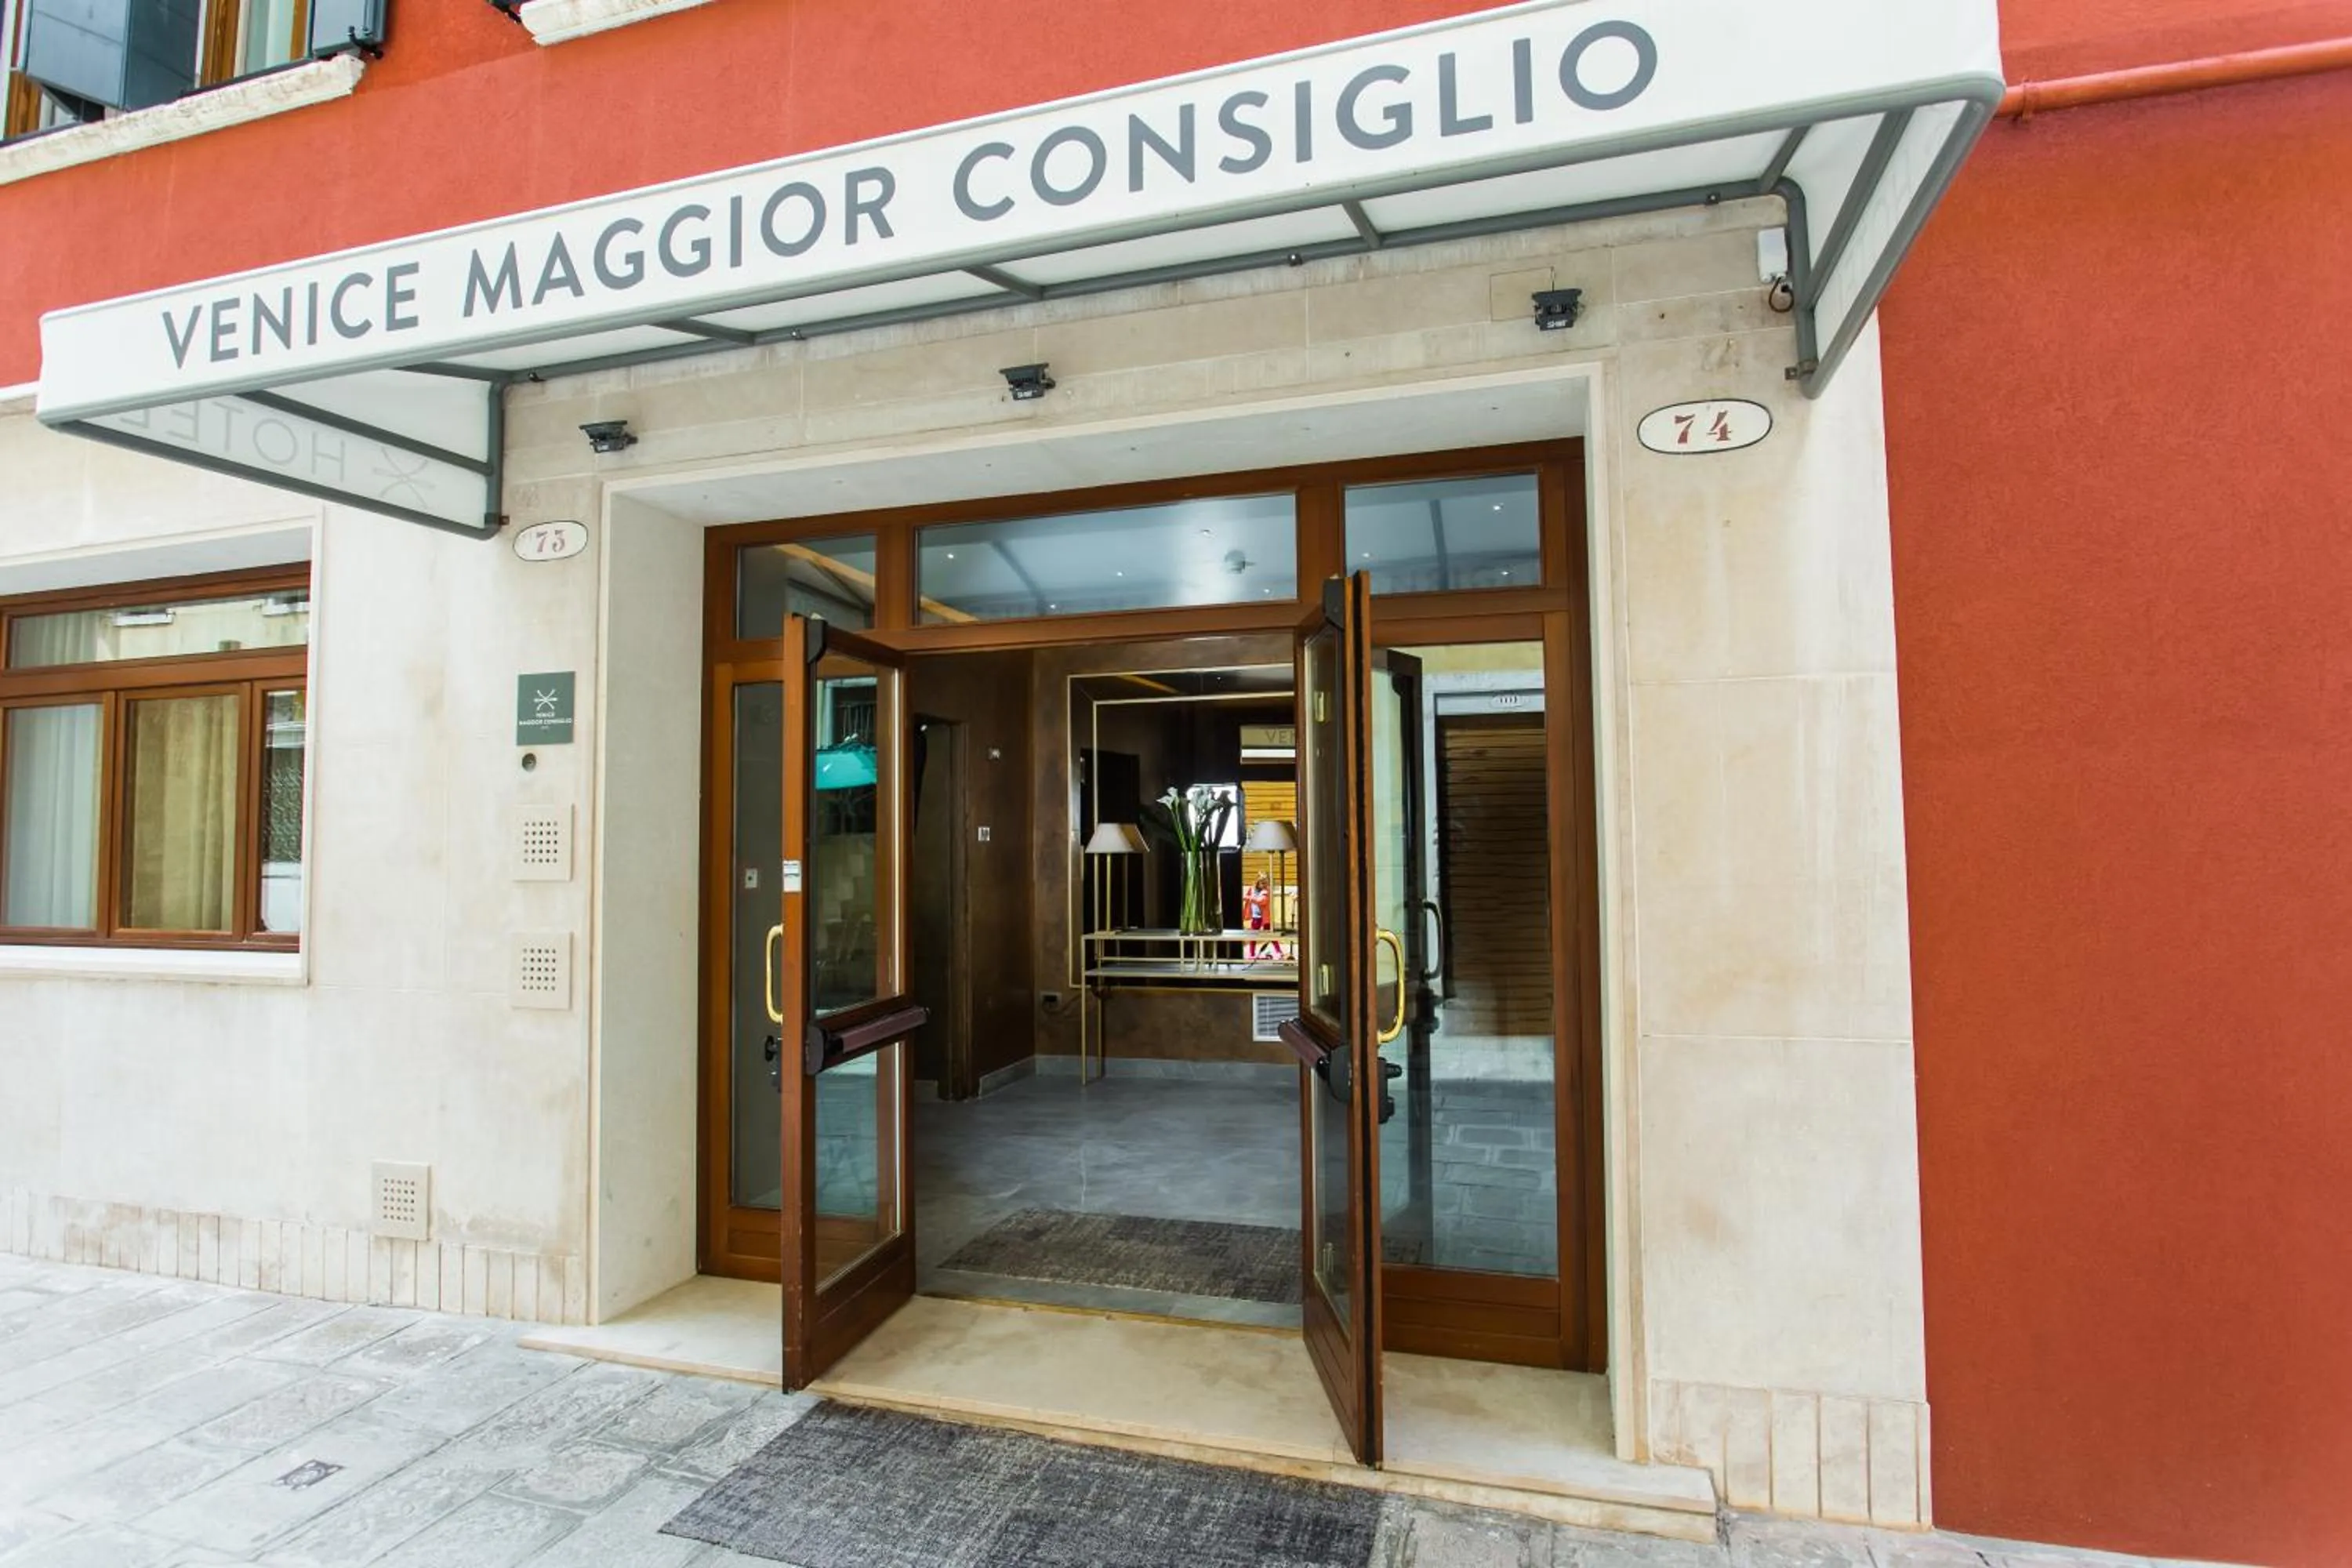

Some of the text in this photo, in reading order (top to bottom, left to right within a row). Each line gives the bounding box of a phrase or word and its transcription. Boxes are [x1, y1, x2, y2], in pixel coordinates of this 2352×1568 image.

[162, 20, 1658, 368] VENICE MAGGIOR CONSIGLIO
[1674, 409, 1733, 445] 74
